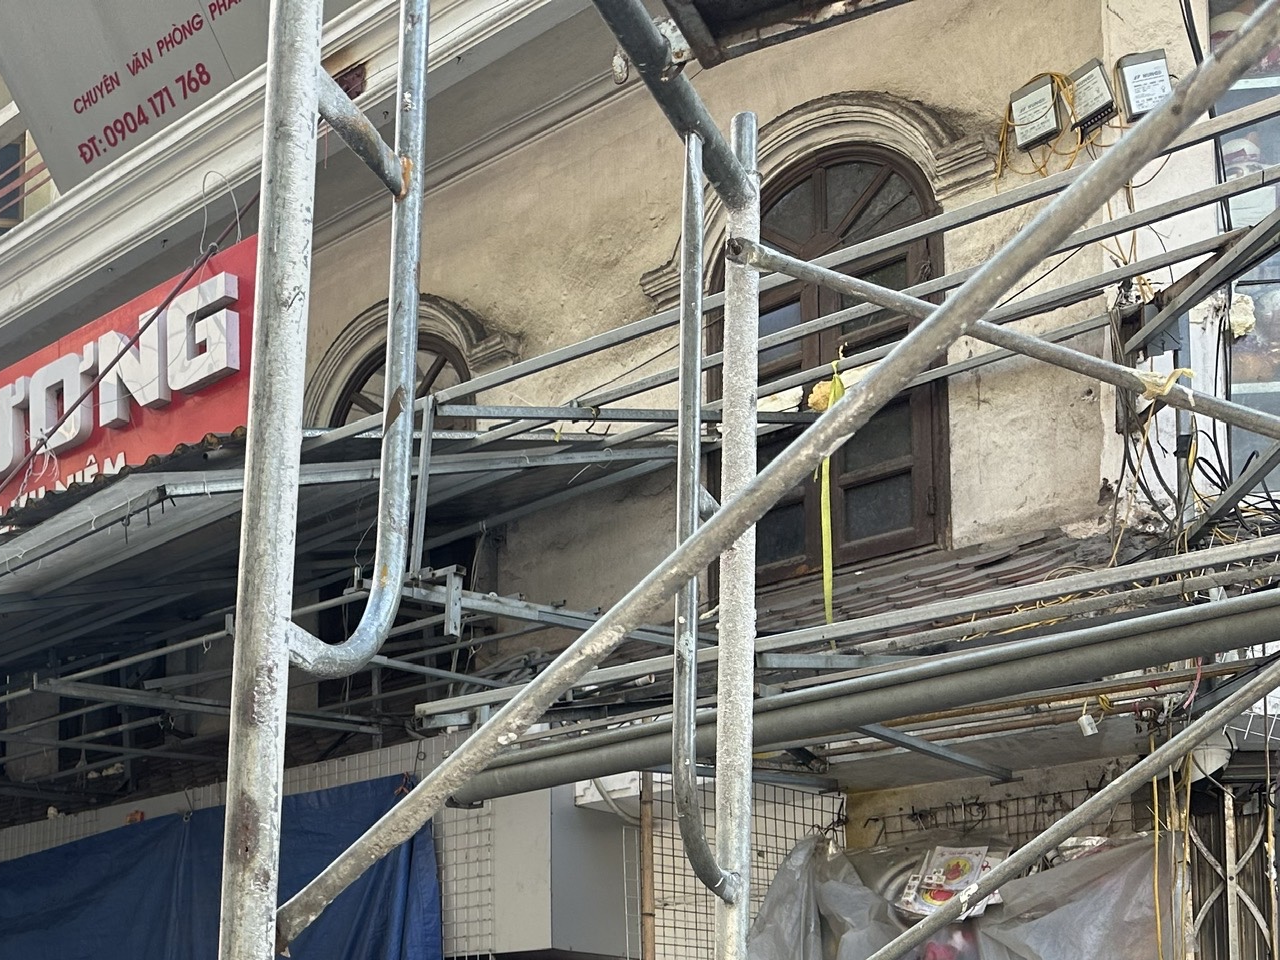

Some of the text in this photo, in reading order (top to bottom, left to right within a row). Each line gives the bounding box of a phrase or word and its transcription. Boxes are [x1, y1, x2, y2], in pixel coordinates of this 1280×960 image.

[73, 71, 121, 114] CHUYÊN
[126, 48, 154, 76] VĂN
[156, 13, 204, 57] PHÒNG
[147, 86, 176, 118] 171
[174, 63, 211, 100] 768
